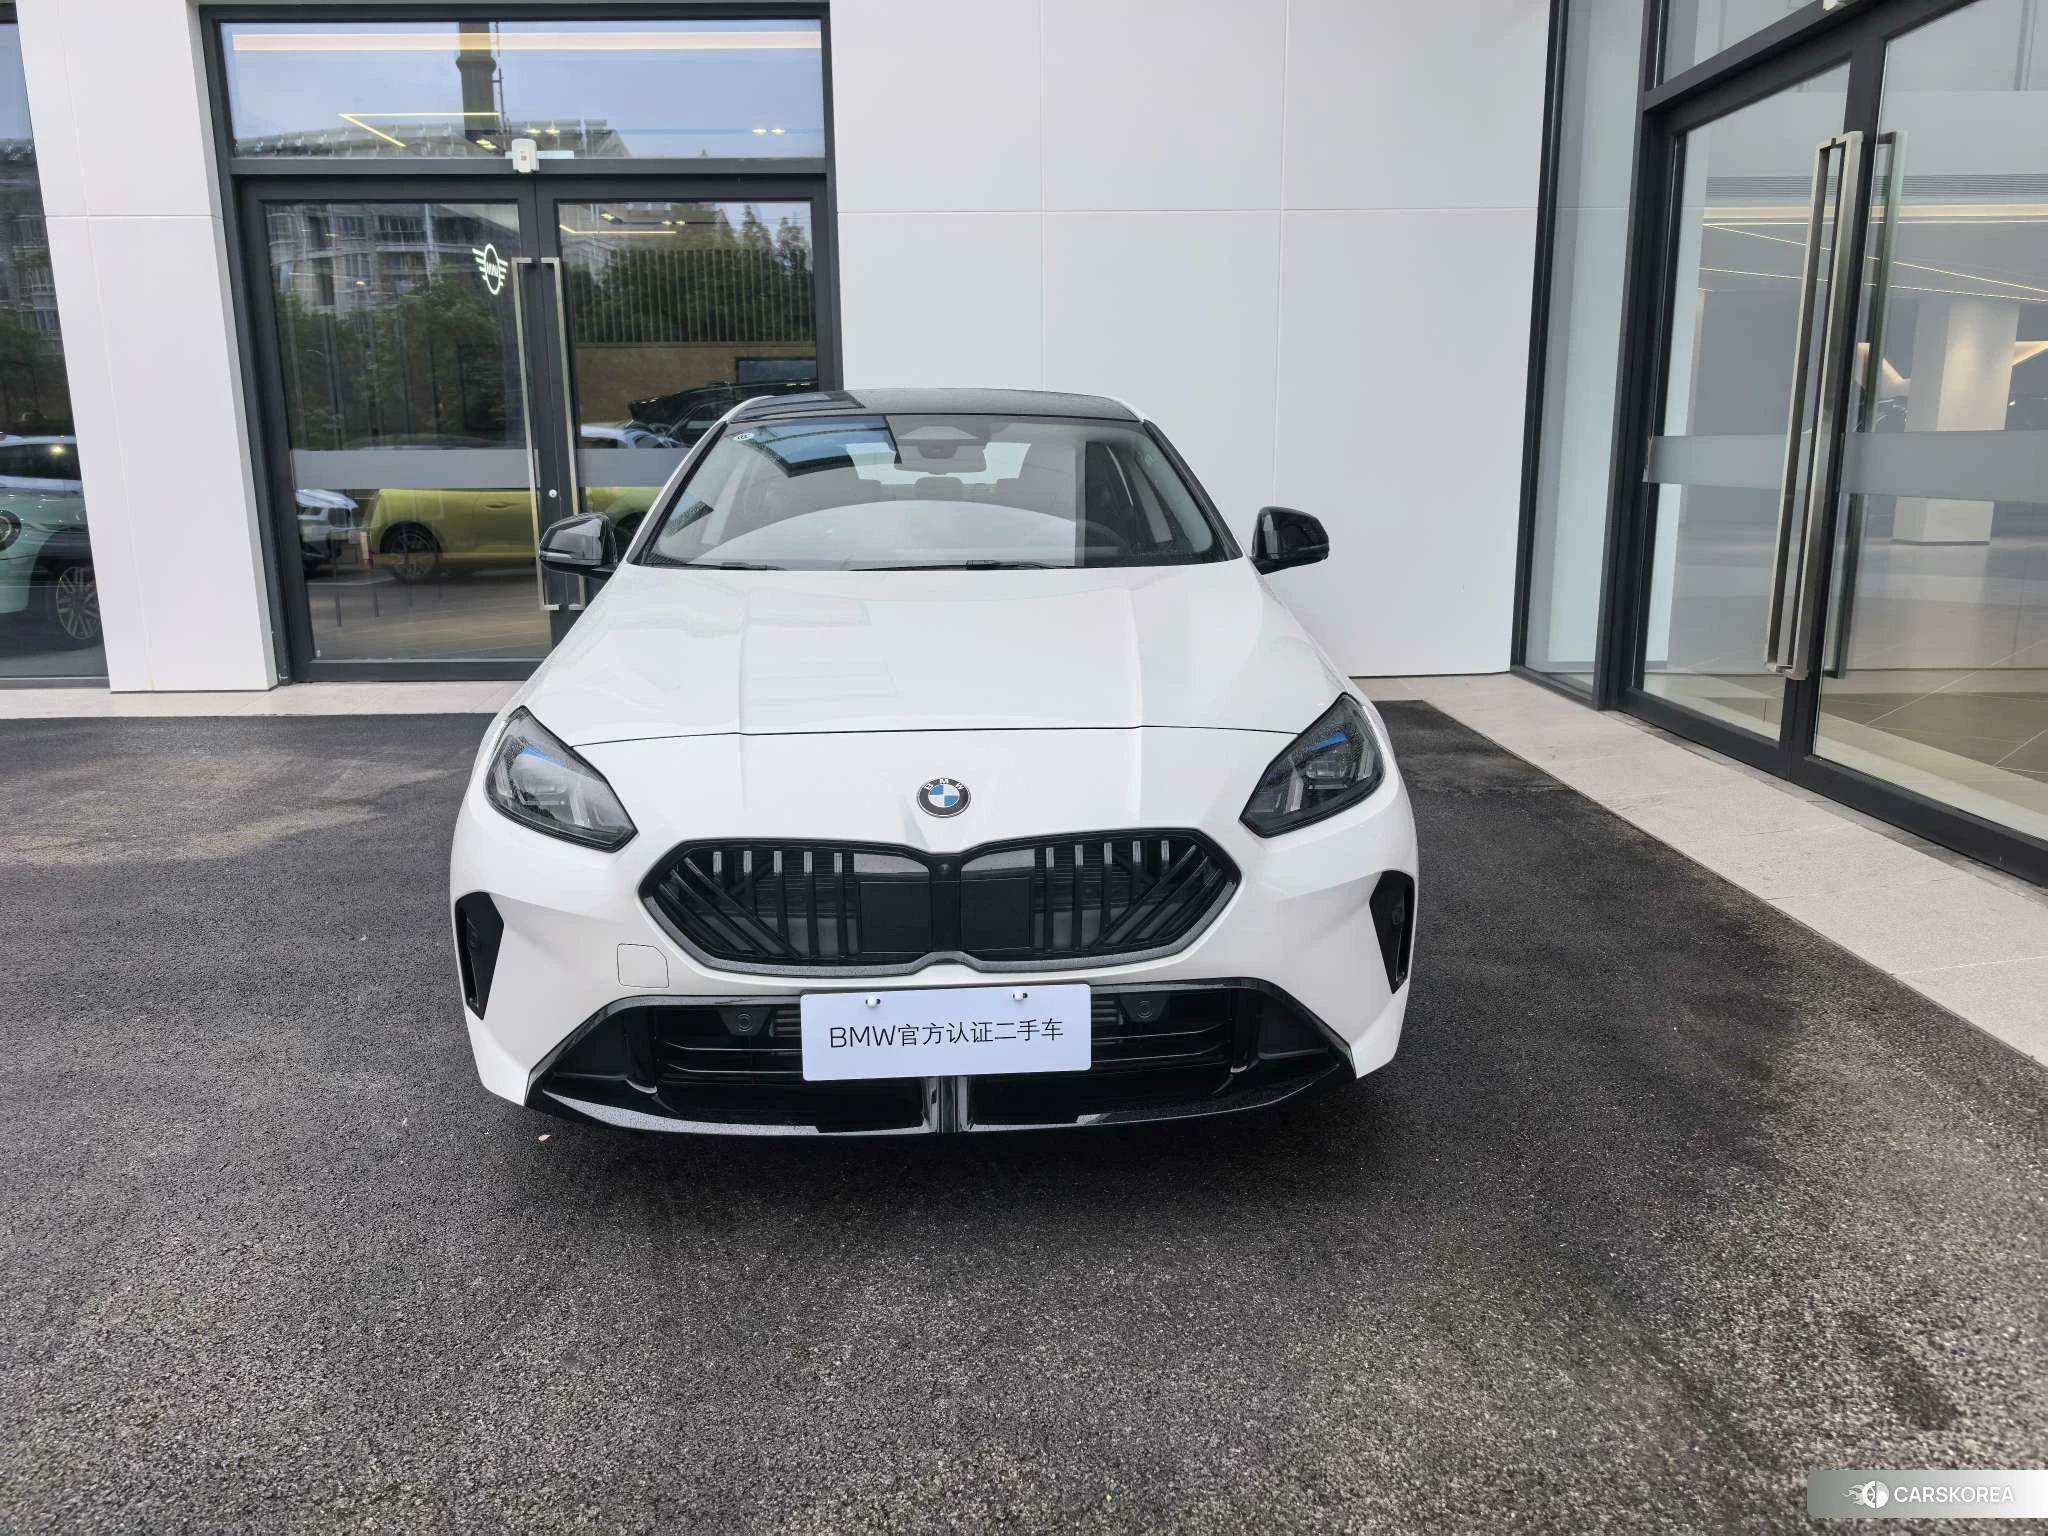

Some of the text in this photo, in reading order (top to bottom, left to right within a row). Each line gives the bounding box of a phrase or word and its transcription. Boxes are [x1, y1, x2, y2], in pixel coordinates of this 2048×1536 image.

[924, 778, 964, 790] BMW
[830, 1018, 1064, 1048] BMW官方认证二手车
